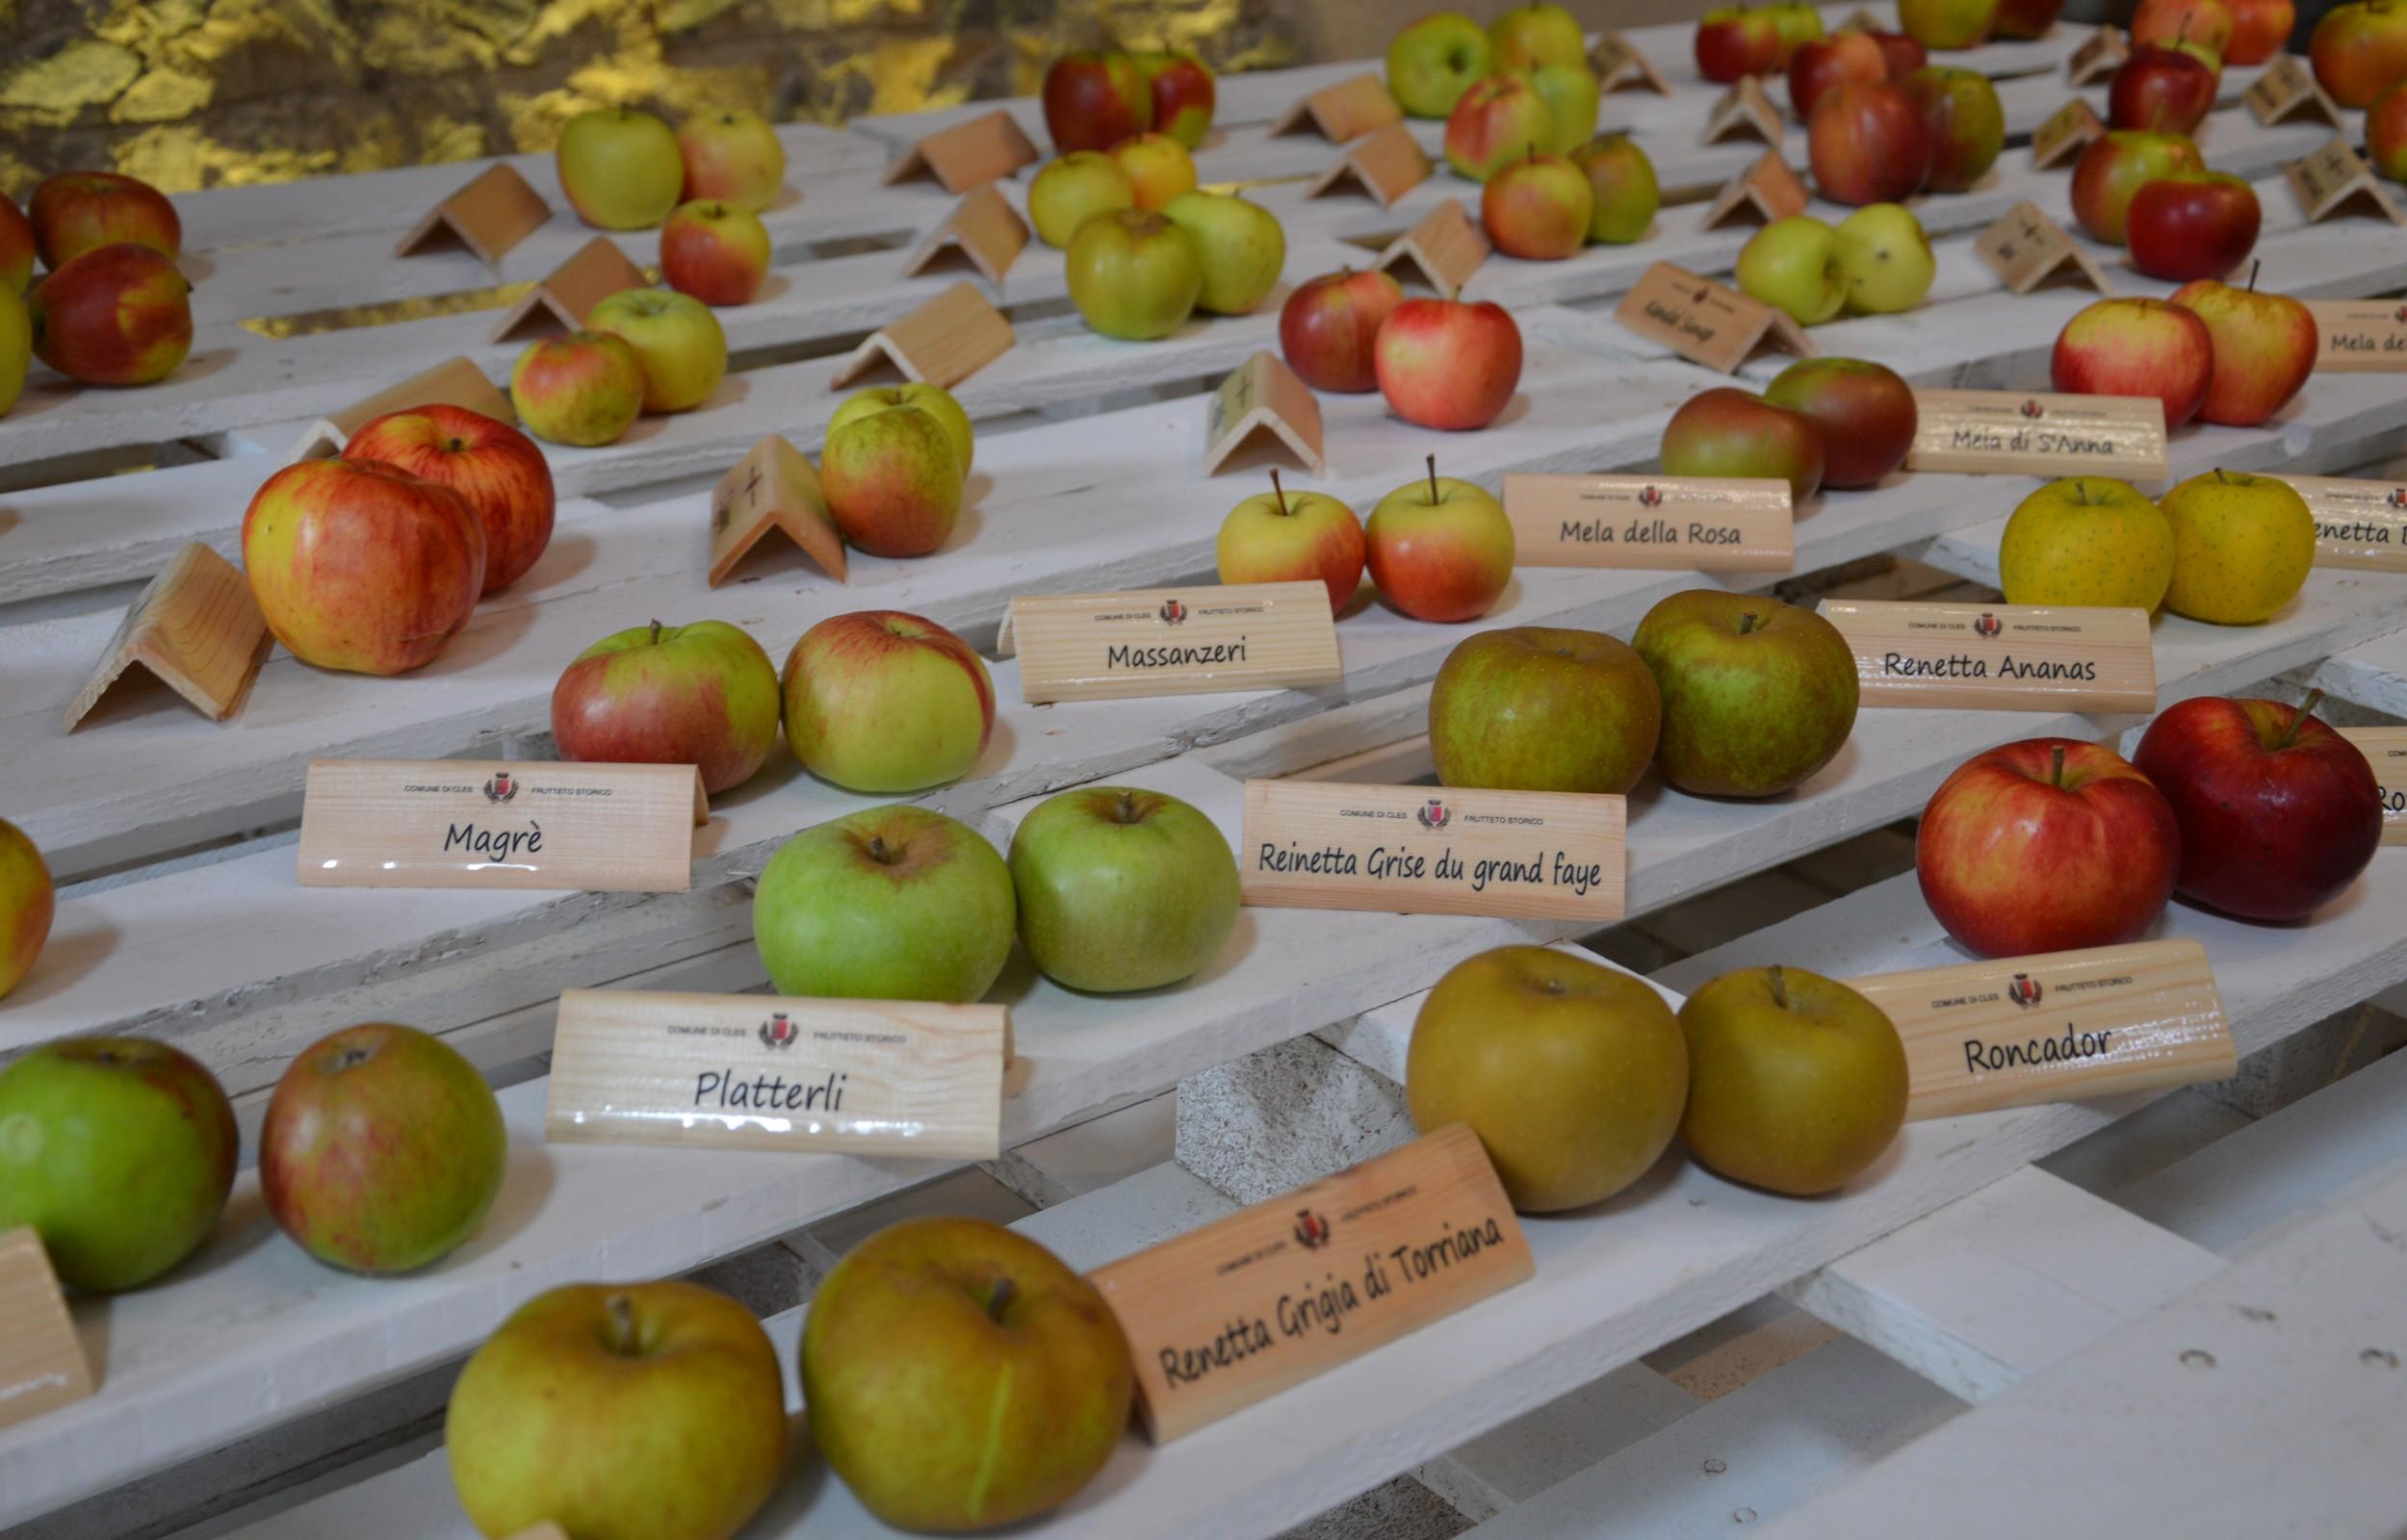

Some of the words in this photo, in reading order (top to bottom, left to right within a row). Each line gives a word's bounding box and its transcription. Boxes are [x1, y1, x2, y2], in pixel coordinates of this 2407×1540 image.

[2331, 331, 2375, 352] Mela
[2010, 429, 2029, 451] di
[2038, 432, 2113, 454] S'Anna
[1560, 520, 1614, 543] Mela
[1624, 520, 1678, 544] della
[1688, 523, 1742, 545] Rosa
[1094, 613, 1124, 622] COMUNE
[1107, 635, 1247, 670] Massanzeri
[1884, 653, 1988, 679] Renetta
[1999, 655, 2097, 681] Ananas
[403, 784, 441, 793] COMUNE
[452, 785, 474, 794] CLES
[576, 788, 612, 797] STORICO
[1339, 809, 1375, 818] COMUNE
[1377, 810, 1385, 819] DI
[1385, 811, 1408, 820] CLES
[1463, 815, 1507, 824] FRUTTETO
[1508, 816, 1544, 826] STORICO
[444, 819, 543, 862] Magrè
[1259, 842, 1357, 876] Reinetta
[1367, 846, 1426, 880] Grise
[1435, 848, 1464, 881] du
[1472, 852, 1543, 892] grand
[1553, 851, 1601, 896] faye
[2054, 980, 2097, 993] FRUTTETO
[2098, 976, 2134, 988] STORICO
[1931, 997, 1967, 1010] COMUNE
[1969, 995, 1977, 1004] DI
[1978, 992, 2000, 1003] CLES
[666, 1025, 708, 1037] COMUNE
[710, 1027, 720, 1037] DI
[721, 1027, 746, 1038] CLES
[814, 1031, 864, 1042] FRUTTETO
[865, 1033, 907, 1044] STORICO
[1963, 1022, 2112, 1074] Roncador
[693, 1068, 848, 1113] Platterli
[1158, 1316, 1275, 1390] Renetta
[1277, 1271, 1359, 1339] Grigia
[1364, 1252, 1391, 1300] di
[1390, 1217, 1505, 1284] Torriana
